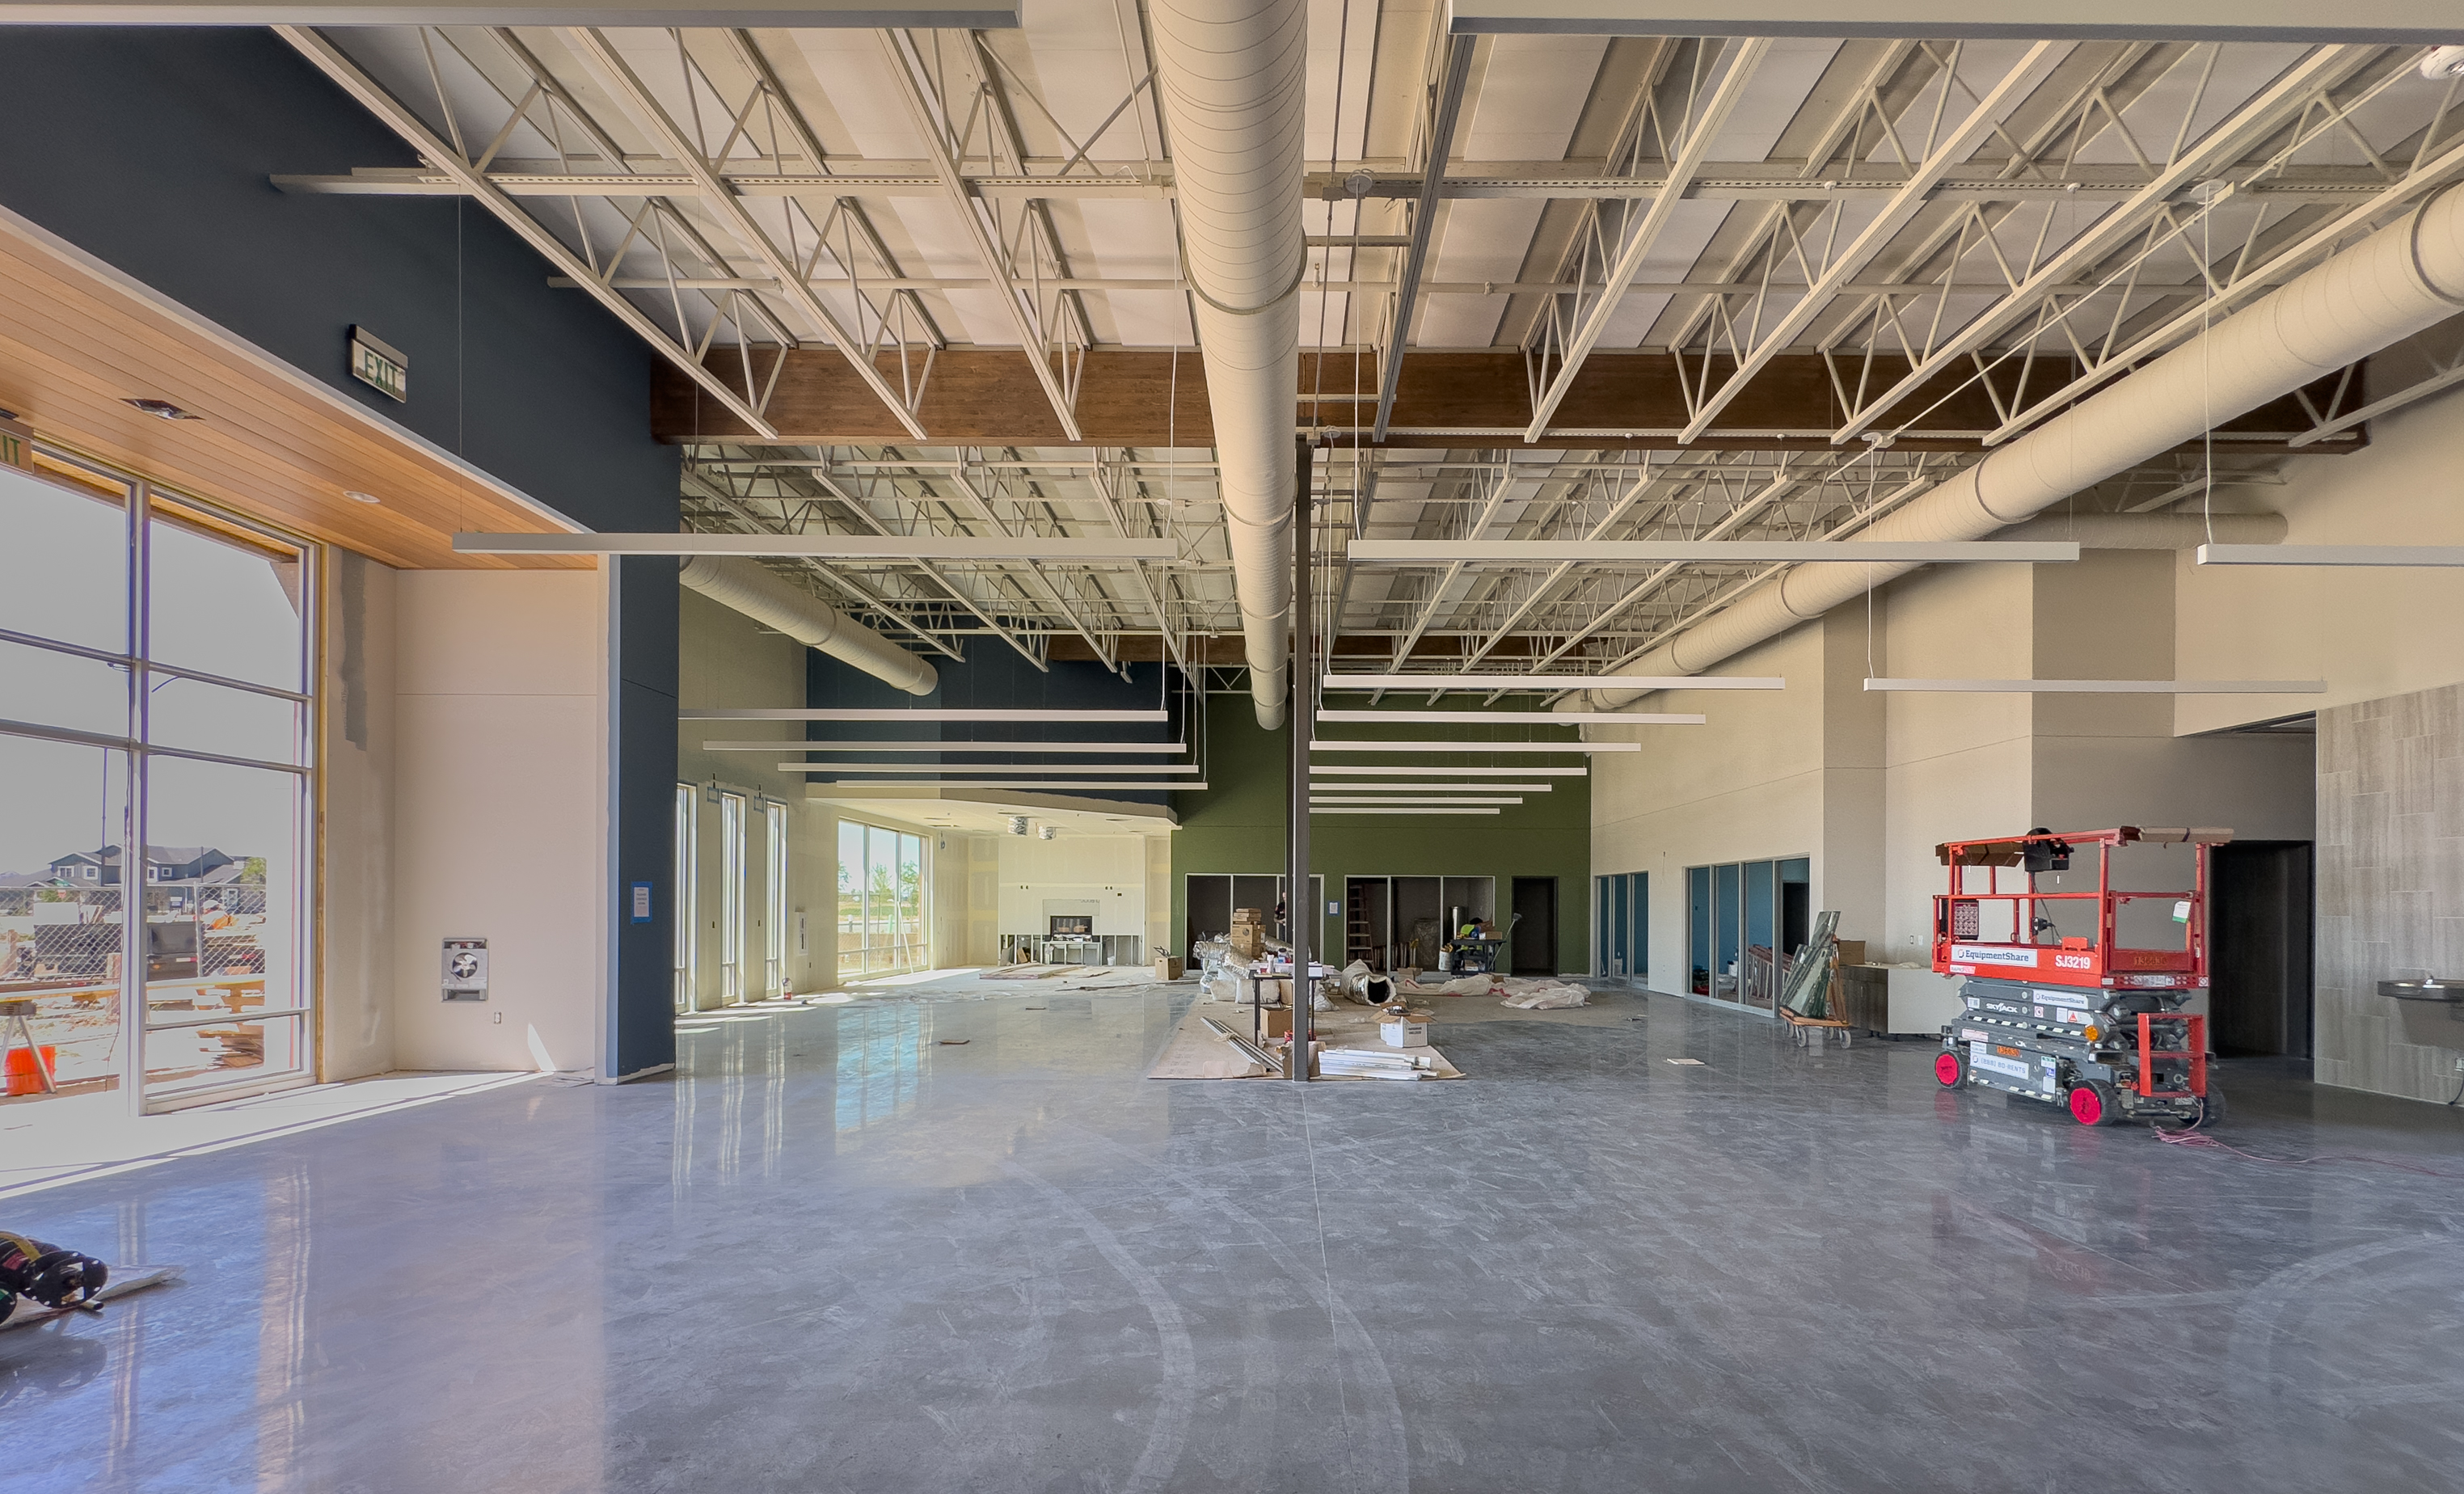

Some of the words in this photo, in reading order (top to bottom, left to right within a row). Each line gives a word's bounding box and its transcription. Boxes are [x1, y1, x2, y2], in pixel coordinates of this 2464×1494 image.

[365, 350, 397, 393] EXIT
[0, 434, 20, 466] IT
[1965, 950, 2029, 962] EquipmentShare
[2055, 955, 2091, 969] SJ3219
[2041, 994, 2085, 1004] EquipmentShare
[1986, 1002, 2018, 1013] SKYJACK
[1998, 1061, 2026, 1074] 80-RENTS
